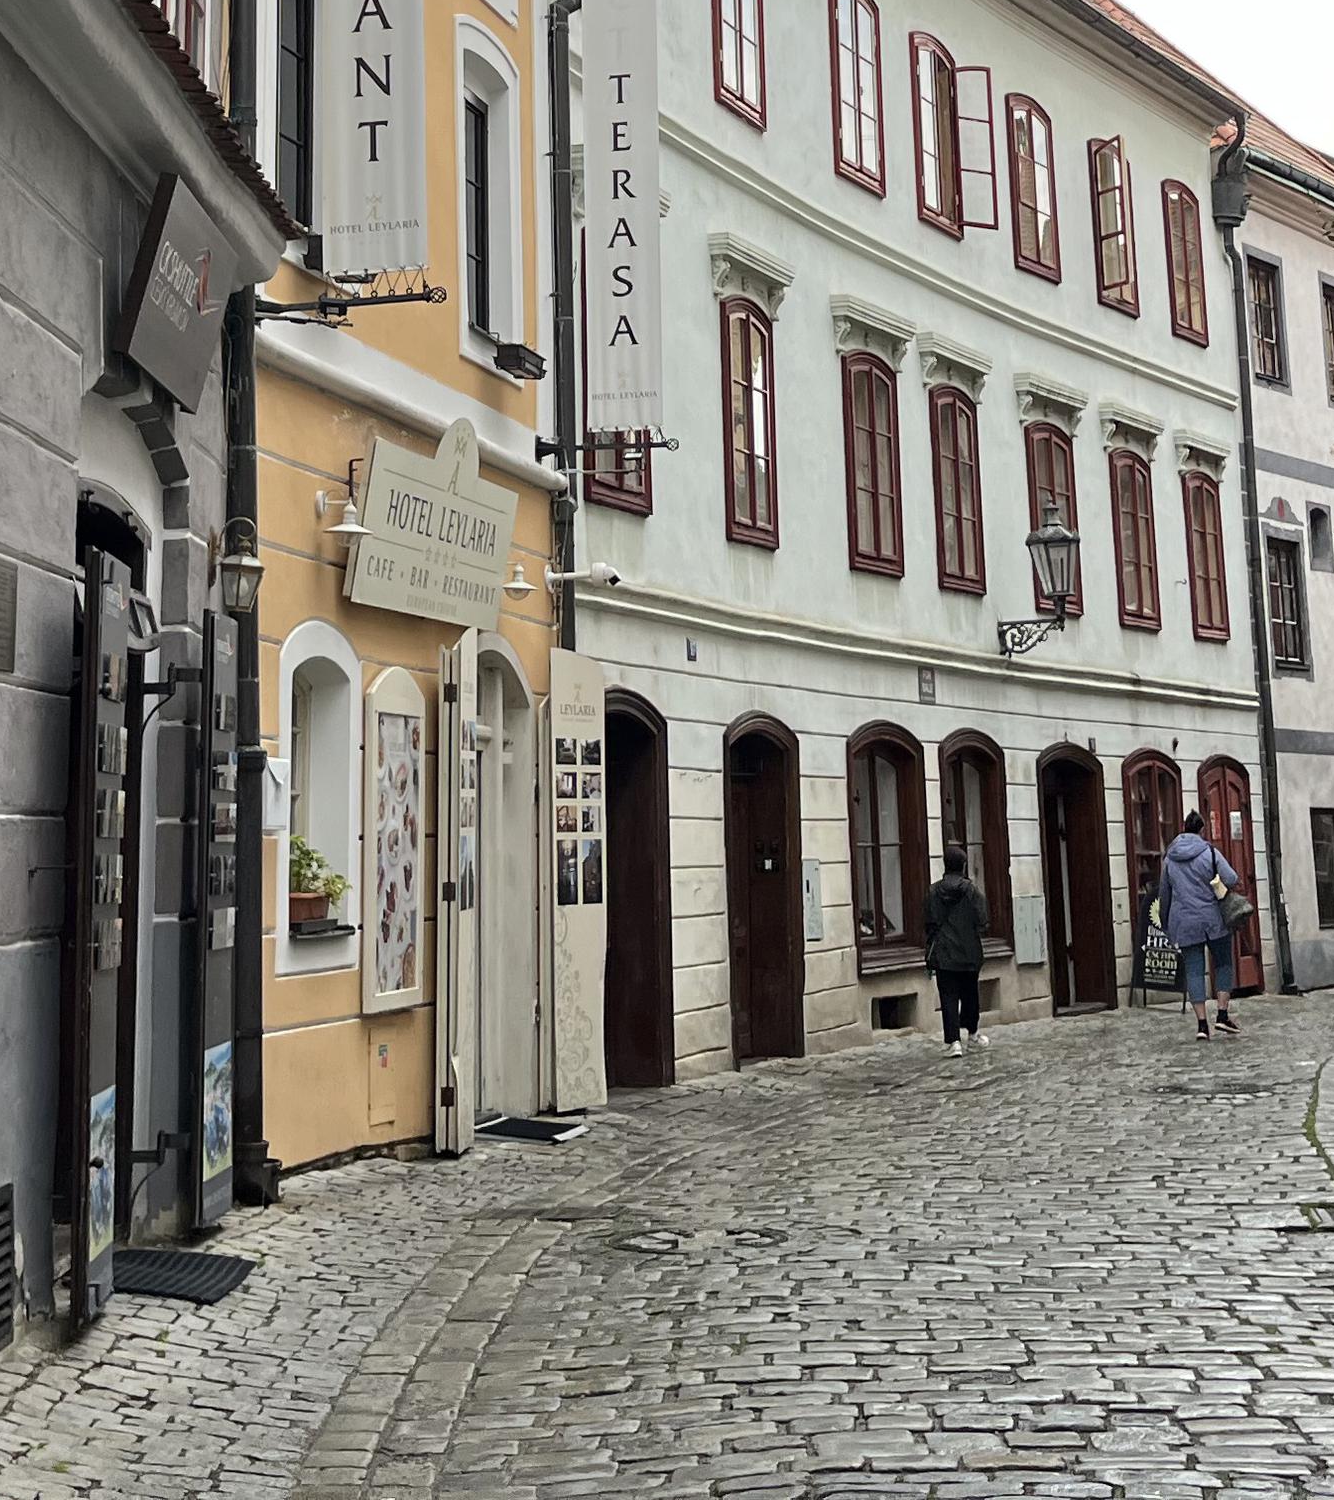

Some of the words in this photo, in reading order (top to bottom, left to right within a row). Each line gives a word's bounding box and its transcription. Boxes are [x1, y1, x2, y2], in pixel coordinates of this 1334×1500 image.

[330, 224, 364, 235] HOTEL
[368, 219, 420, 232] LEYLARIA
[607, 73, 639, 347] TERASA
[386, 488, 434, 538] HOTEL
[438, 506, 497, 557] LEYLARIA
[410, 566, 430, 589] BAR
[442, 574, 496, 606] RESTAURANT
